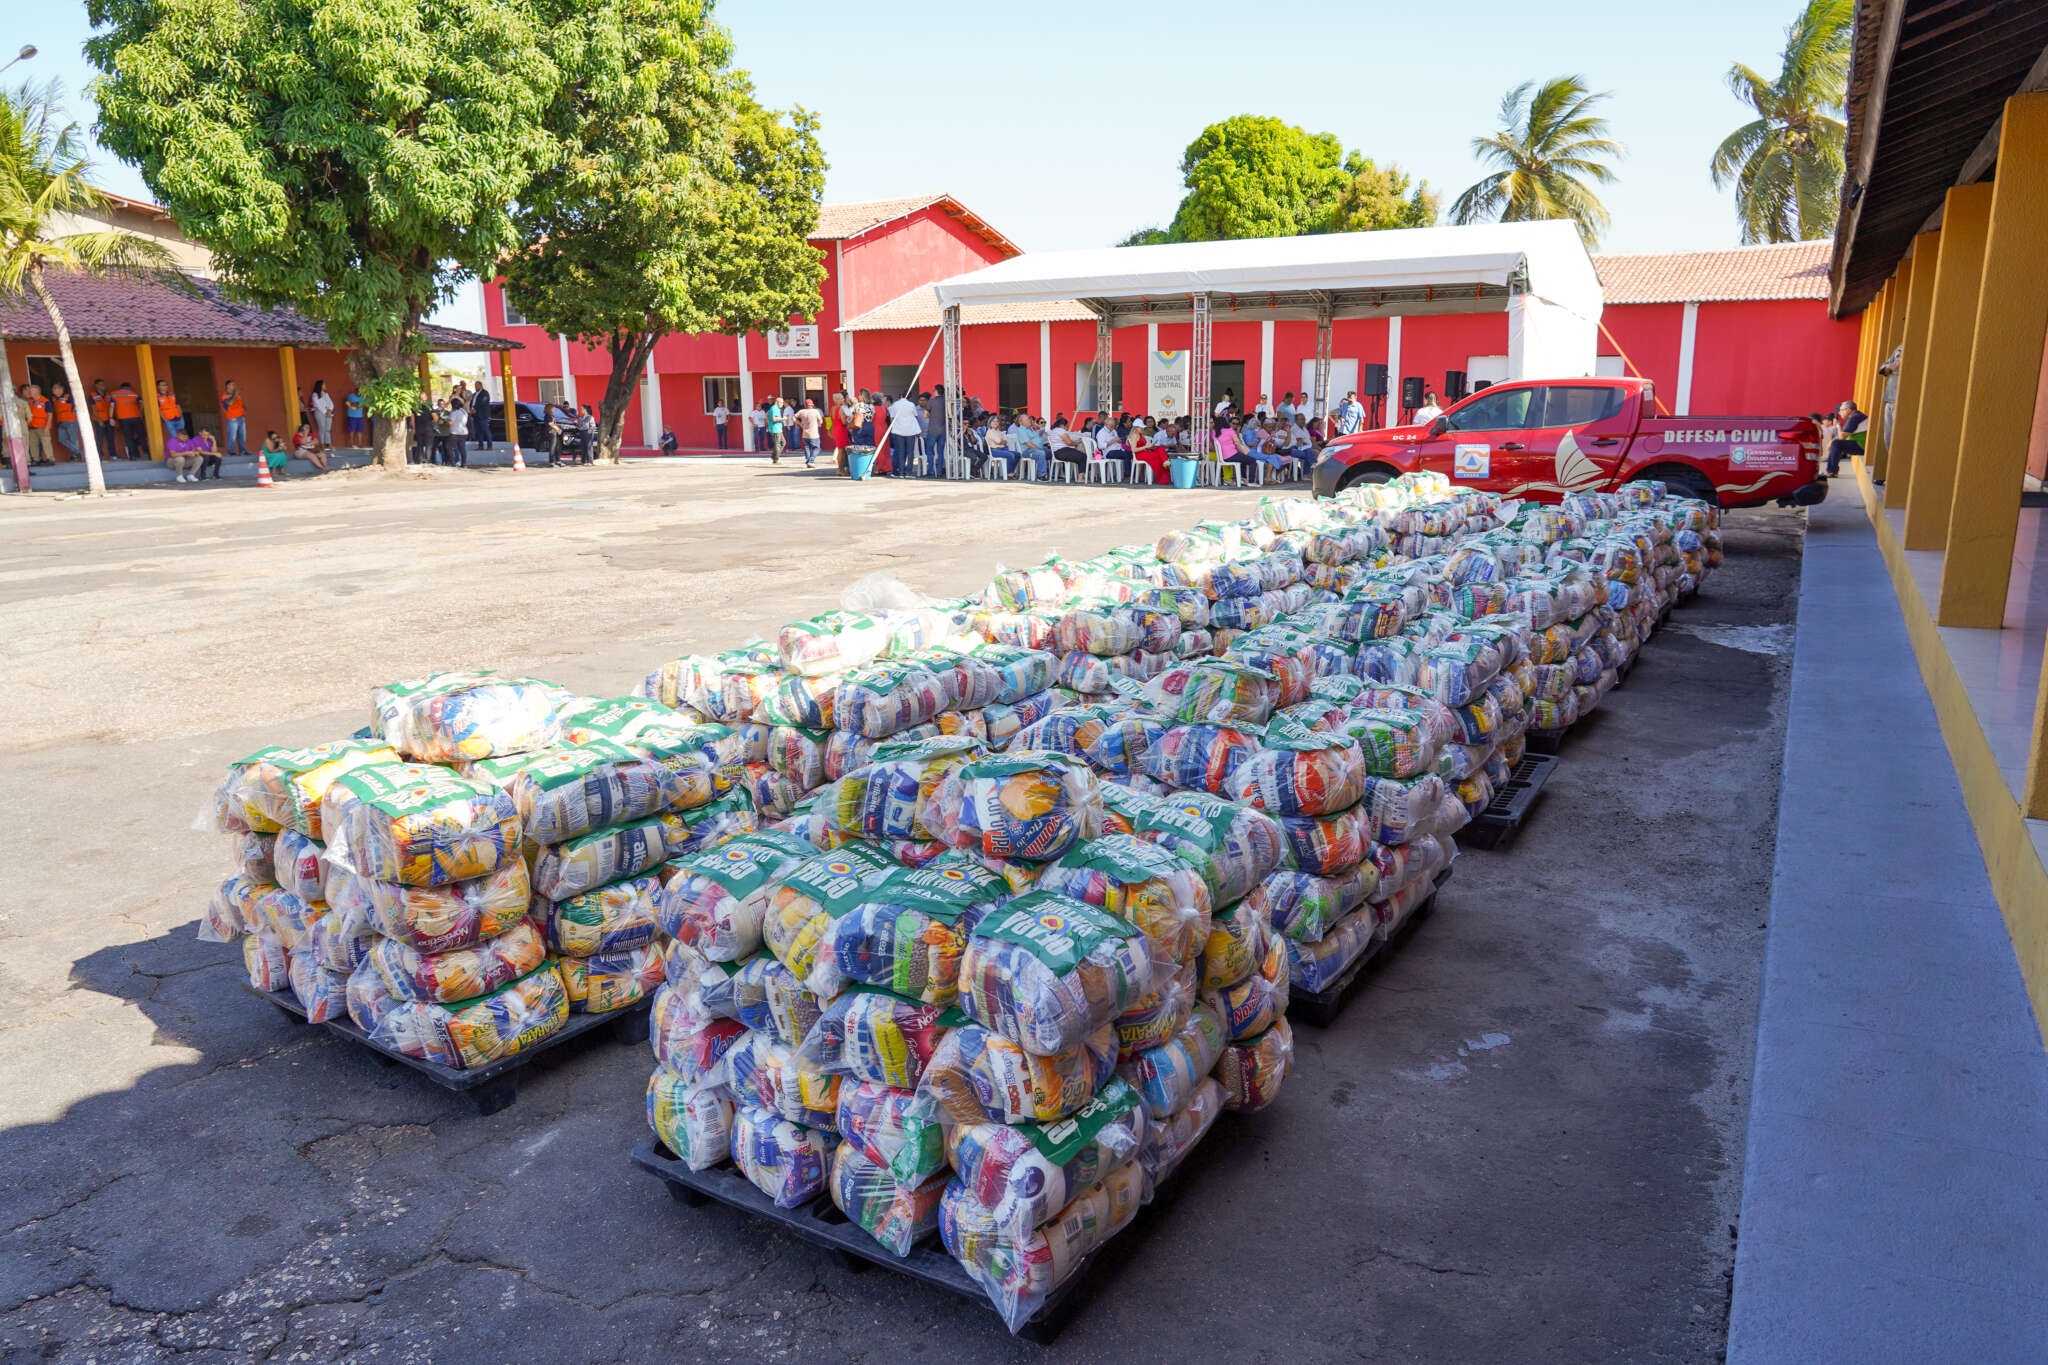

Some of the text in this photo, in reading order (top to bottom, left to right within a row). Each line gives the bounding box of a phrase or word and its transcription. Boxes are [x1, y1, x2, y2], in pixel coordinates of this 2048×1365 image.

[1663, 429, 1778, 444] DEFESA CIVIL
[993, 909, 1076, 957] CEARÁ
